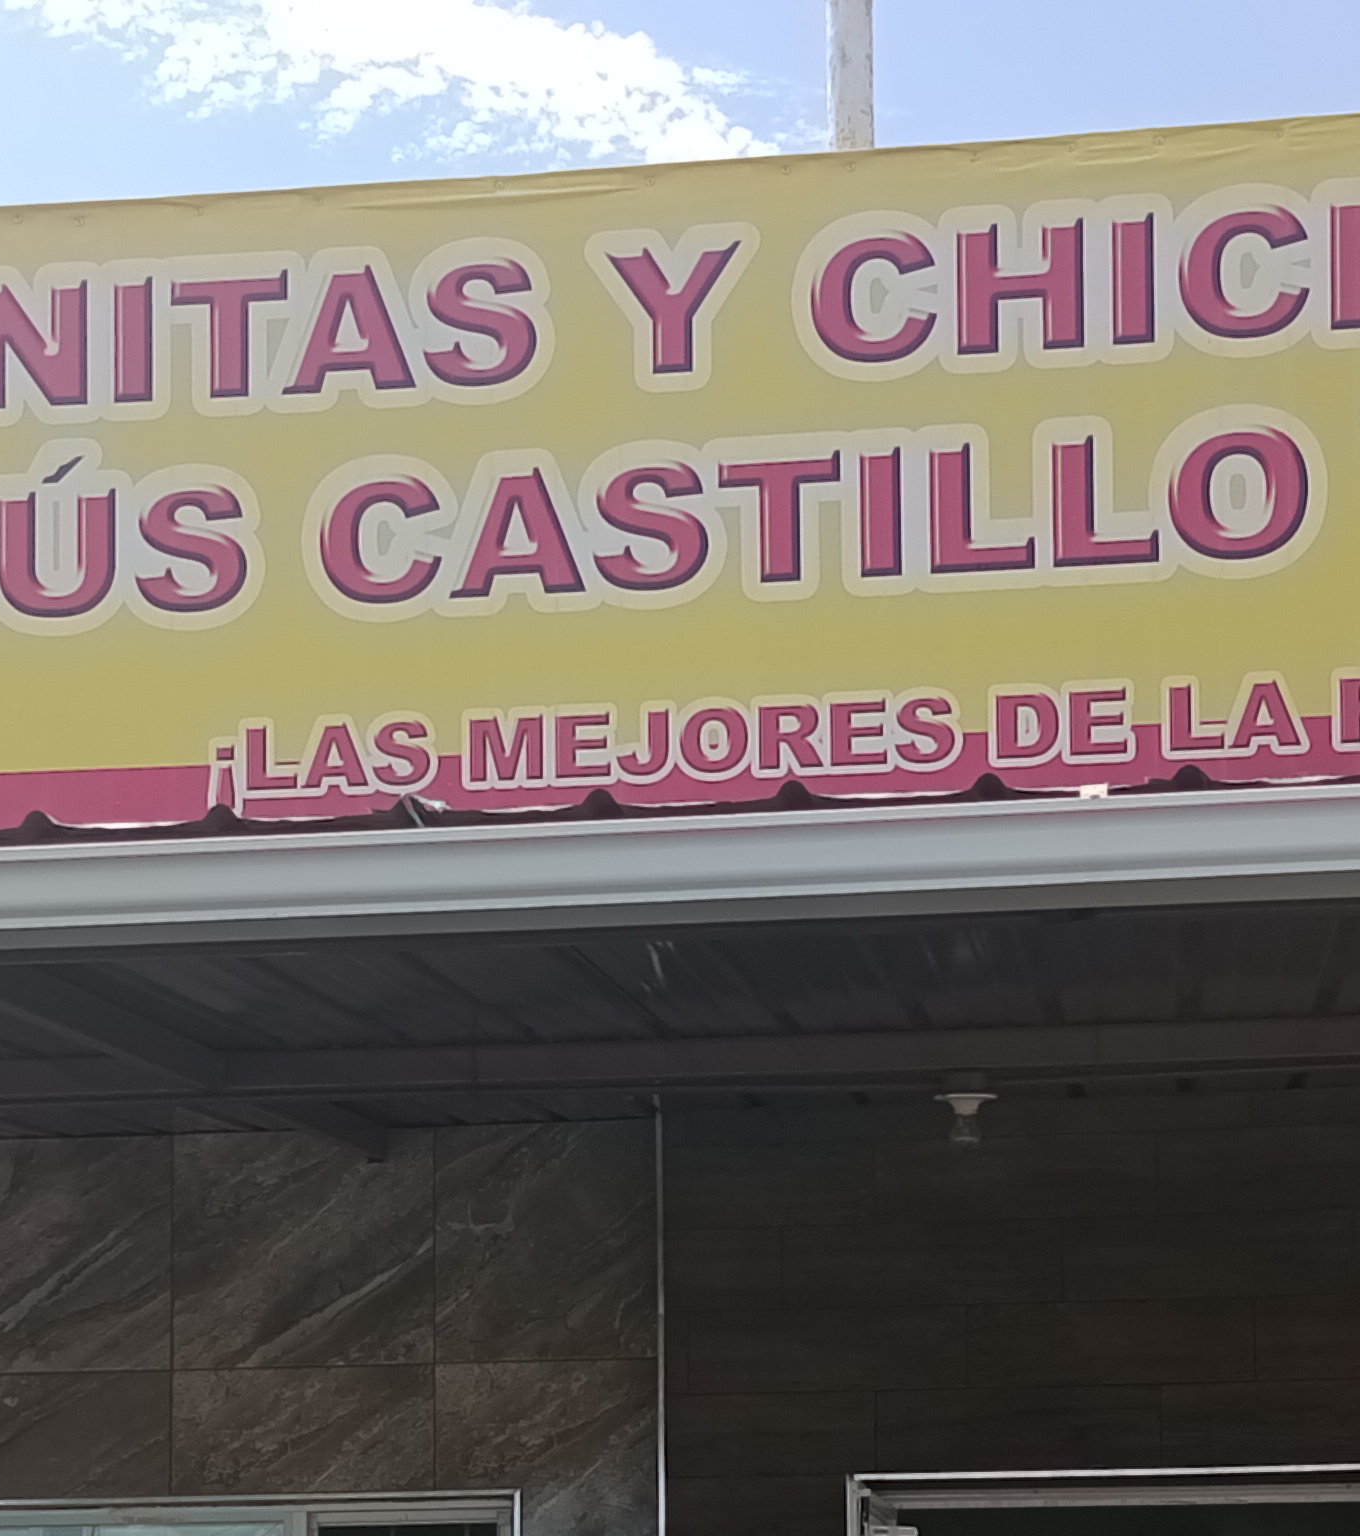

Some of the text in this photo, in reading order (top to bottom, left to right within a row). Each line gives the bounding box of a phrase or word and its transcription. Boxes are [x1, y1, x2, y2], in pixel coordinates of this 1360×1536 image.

[604, 240, 742, 375] Y
[320, 424, 1309, 604] CASTILLO
[468, 696, 958, 785] MEJORES
[996, 687, 1133, 760] DE
[1167, 680, 1300, 752] LA
